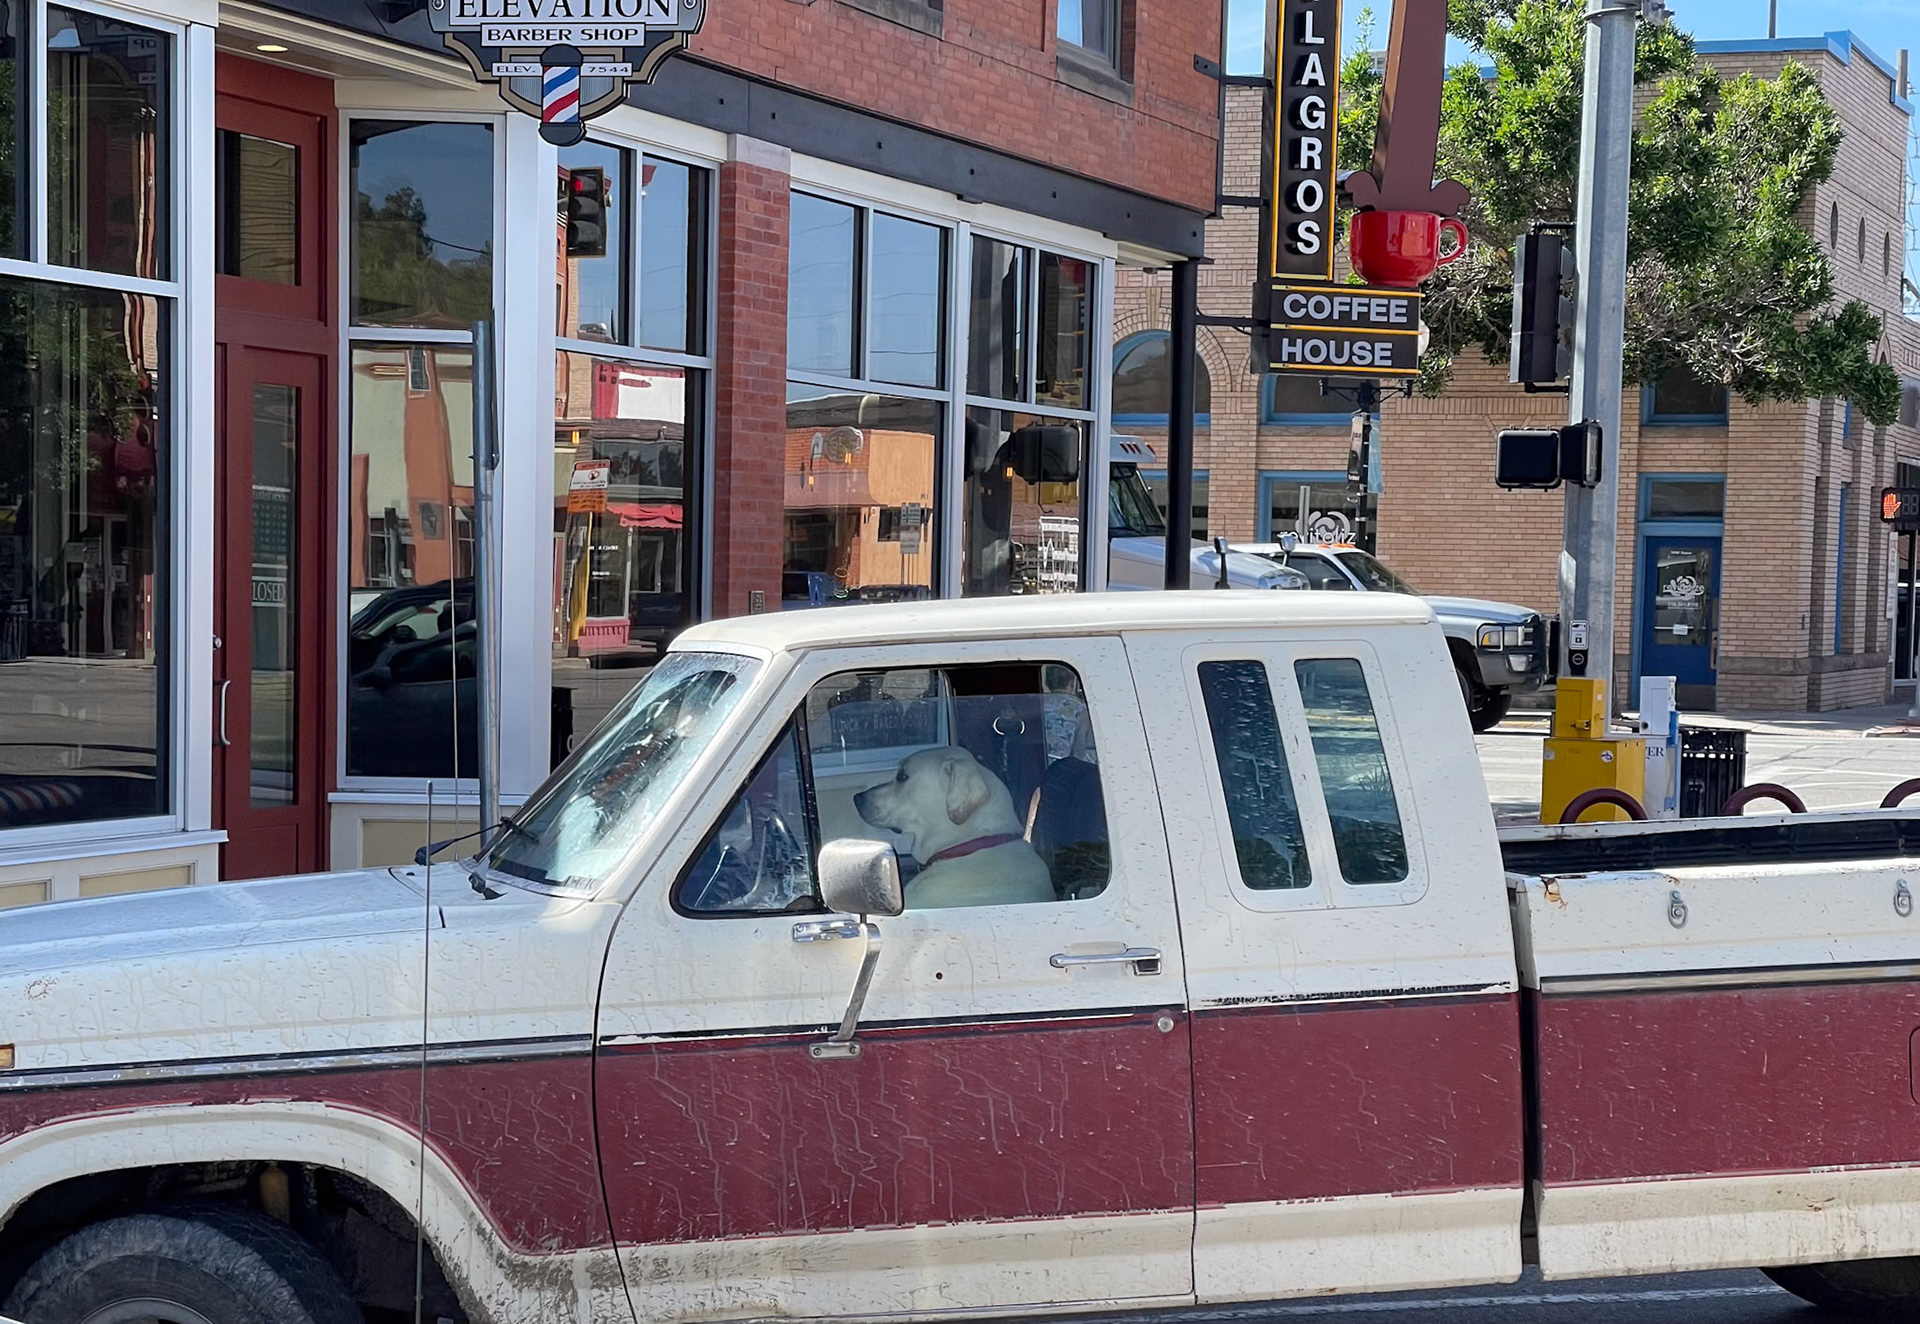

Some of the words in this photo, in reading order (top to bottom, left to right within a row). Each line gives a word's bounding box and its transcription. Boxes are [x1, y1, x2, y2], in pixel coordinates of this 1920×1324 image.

[487, 28, 572, 41] BARBER
[580, 28, 639, 41] SHOP
[496, 65, 536, 73] ELEV.
[588, 65, 629, 73] 7544
[1295, 8, 1327, 255] LAGROS
[1283, 293, 1408, 324] COFFEE
[1281, 337, 1393, 367] HOUSE
[252, 581, 287, 602] LOSED
[1645, 746, 1664, 758] ER
